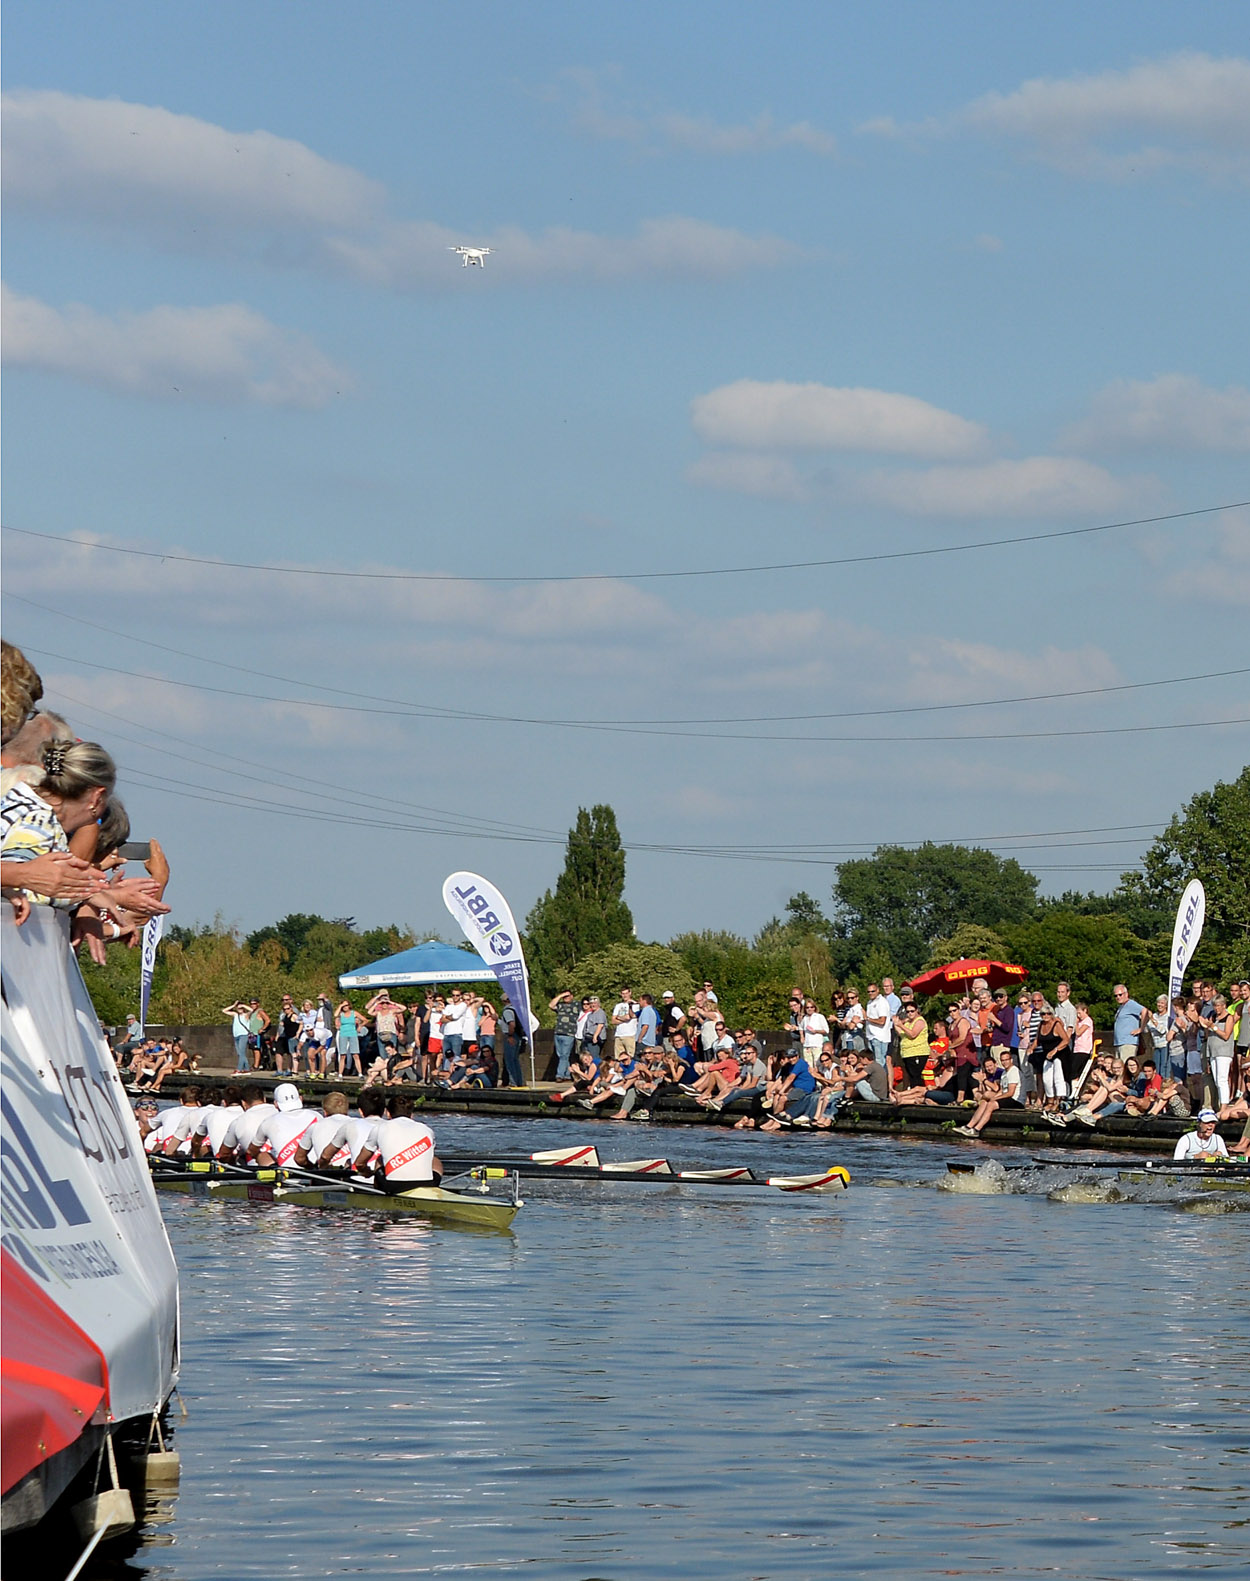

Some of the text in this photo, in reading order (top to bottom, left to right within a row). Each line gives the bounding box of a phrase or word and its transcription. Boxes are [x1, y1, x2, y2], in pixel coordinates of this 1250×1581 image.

[1181, 895, 1199, 944] RBL
[948, 966, 988, 980] DLRG
[390, 1142, 428, 1169] RC Witten
